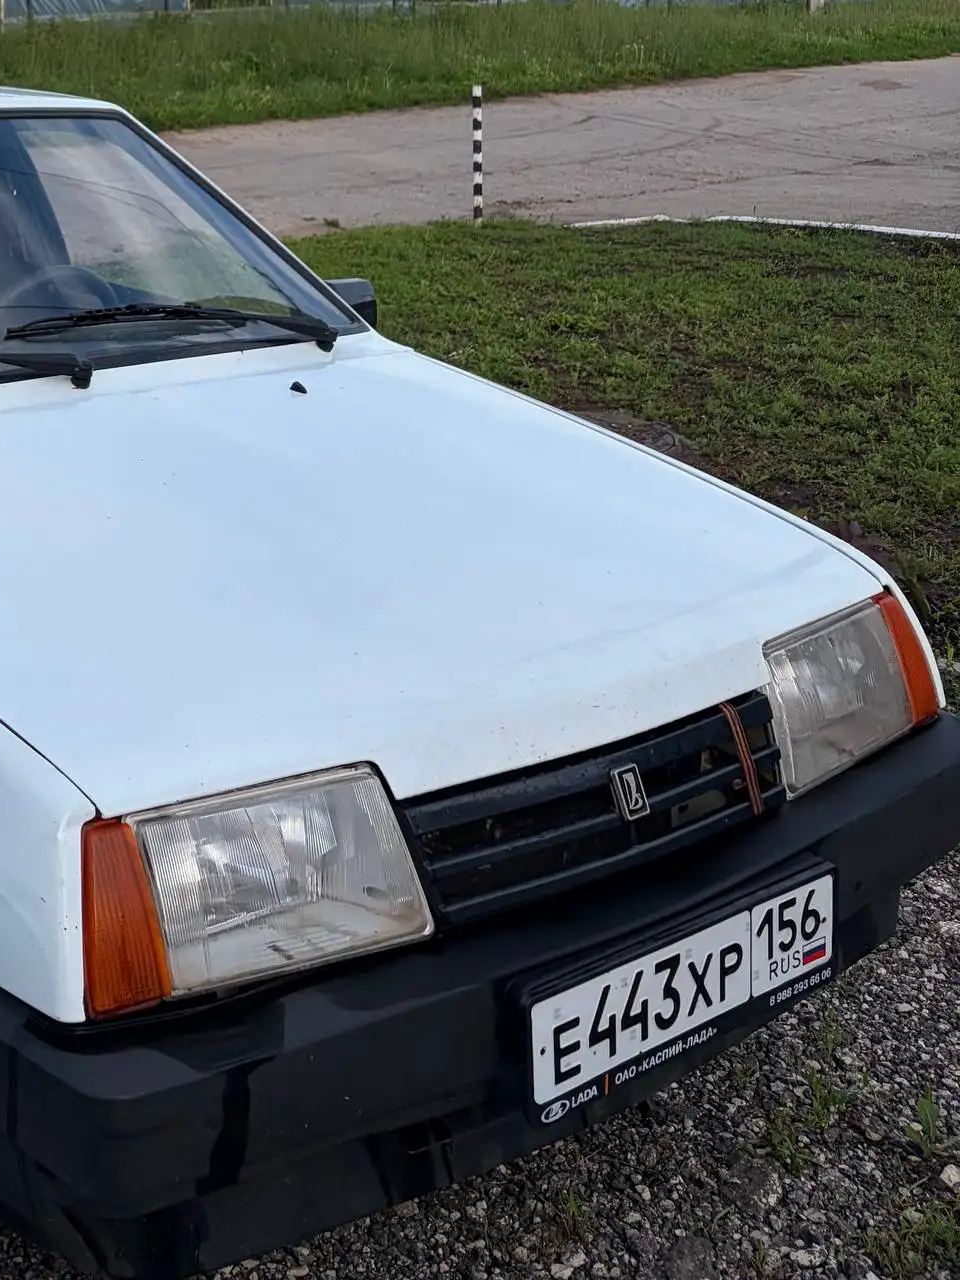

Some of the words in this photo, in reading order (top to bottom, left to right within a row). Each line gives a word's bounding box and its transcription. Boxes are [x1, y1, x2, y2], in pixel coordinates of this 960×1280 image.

[756, 888, 821, 961] 156
[769, 950, 802, 981] RUS
[769, 995, 776, 1007] 8
[776, 987, 792, 1003] 988
[793, 978, 809, 995] 293
[821, 967, 832, 980] 06
[552, 942, 744, 1086] Е443ХР
[615, 1066, 637, 1085] ОАО
[637, 1026, 718, 1072] «КАСПИЙ-ЛАДА»
[571, 1085, 598, 1108] LADA
